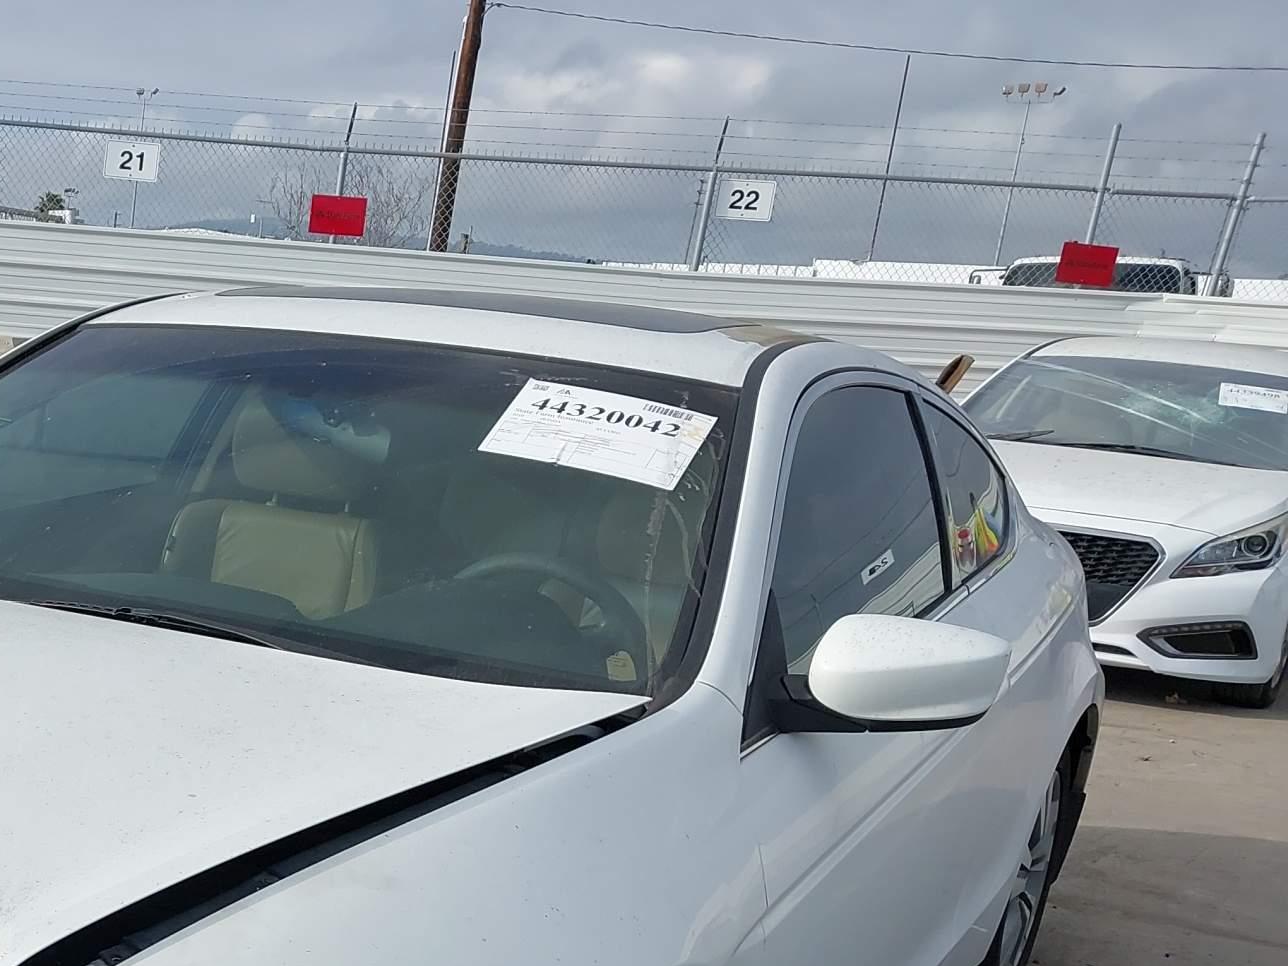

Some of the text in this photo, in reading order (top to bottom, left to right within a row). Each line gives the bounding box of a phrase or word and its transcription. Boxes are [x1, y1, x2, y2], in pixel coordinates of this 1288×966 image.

[118, 149, 146, 172] 21
[727, 188, 760, 212] 22
[531, 397, 681, 437] 44320042
